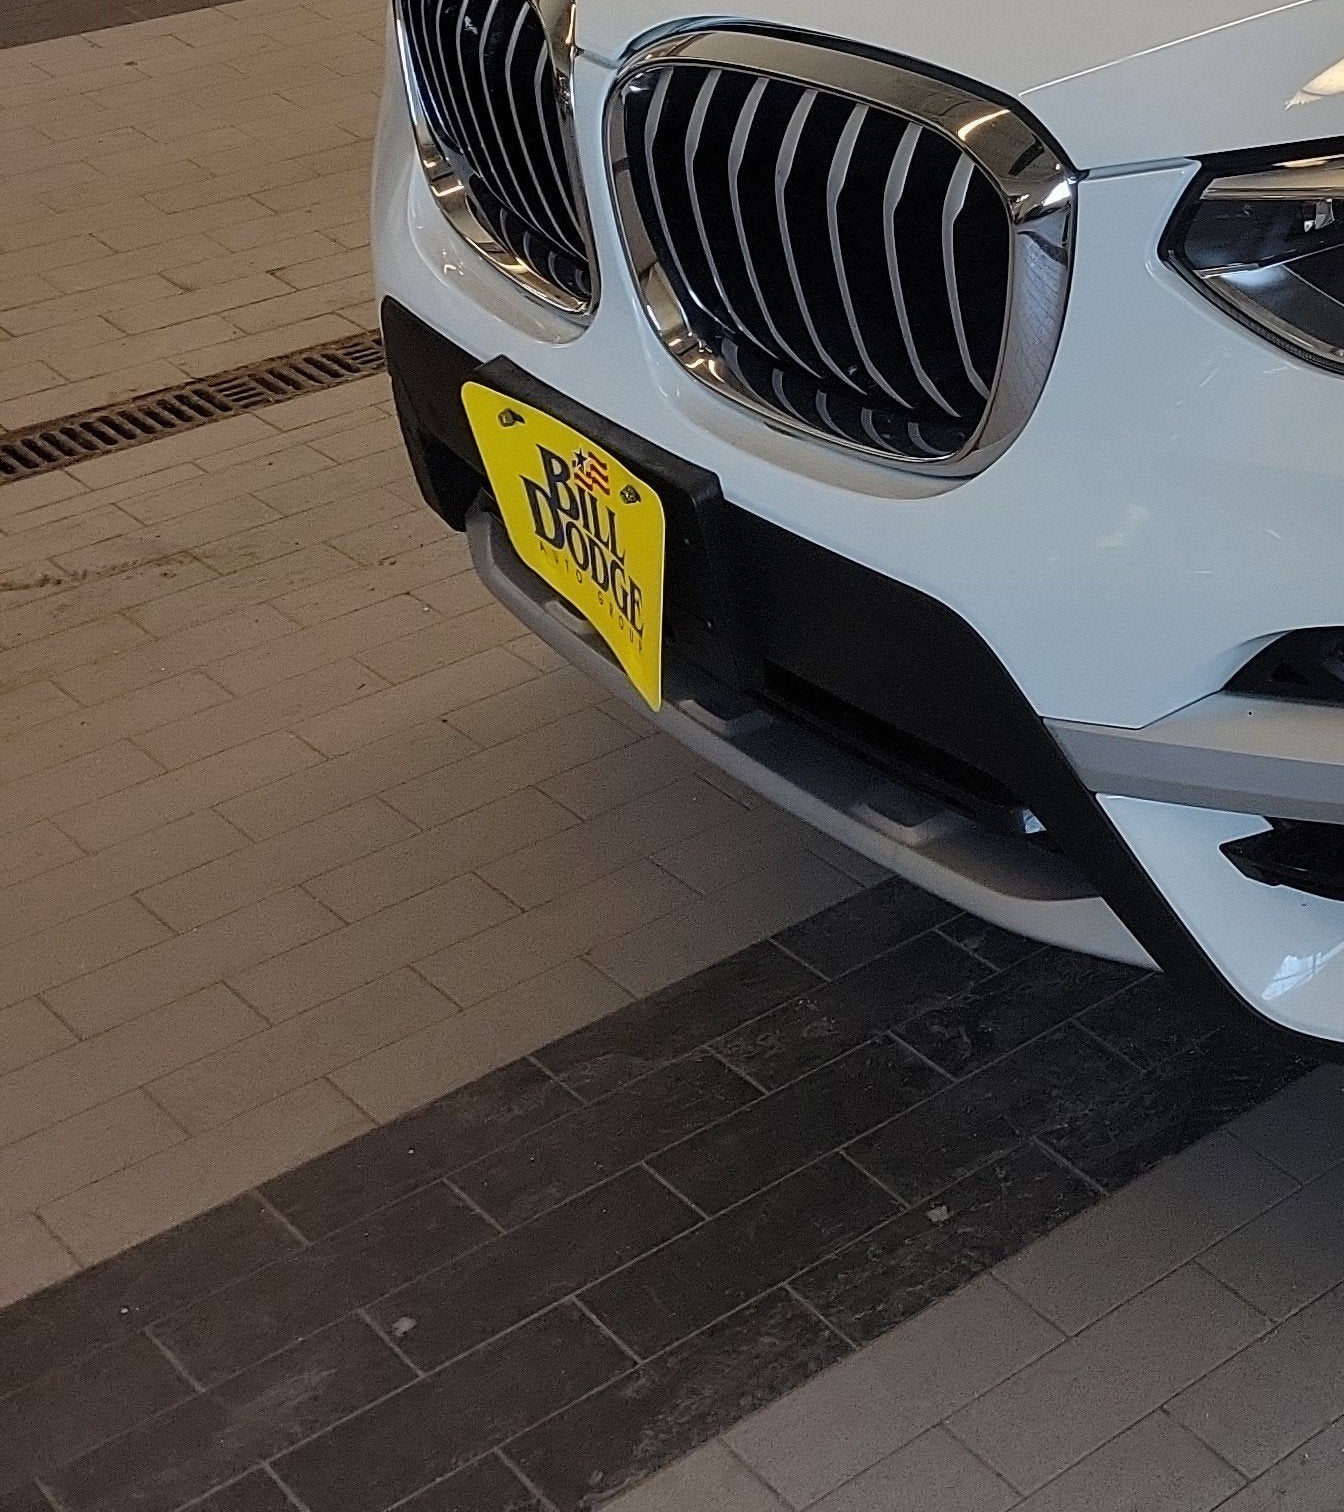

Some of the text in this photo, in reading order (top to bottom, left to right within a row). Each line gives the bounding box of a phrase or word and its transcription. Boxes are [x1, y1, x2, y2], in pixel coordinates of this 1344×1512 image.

[520, 474, 645, 638] DODGE
[536, 443, 626, 566] BILL
[539, 540, 583, 584] AUTO
